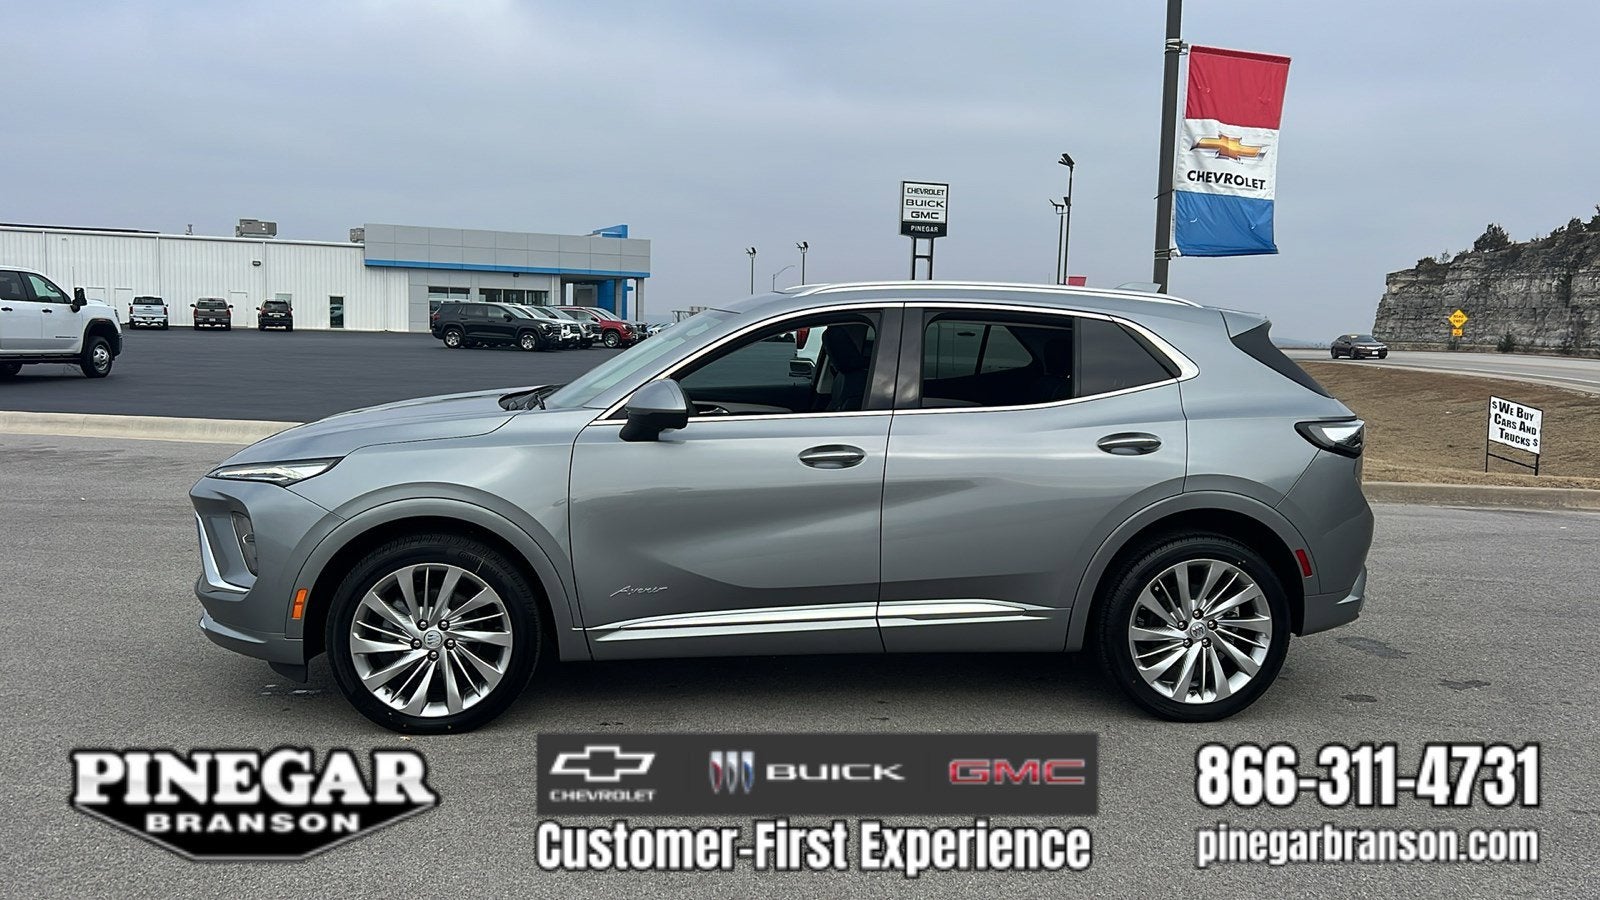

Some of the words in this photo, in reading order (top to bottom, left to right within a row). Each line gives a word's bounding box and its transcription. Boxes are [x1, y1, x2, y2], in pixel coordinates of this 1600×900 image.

[1187, 169, 1266, 190] CHEVROLET
[907, 187, 945, 195] CHEVROLET
[906, 199, 944, 208] BUICK
[910, 211, 939, 219] GMC
